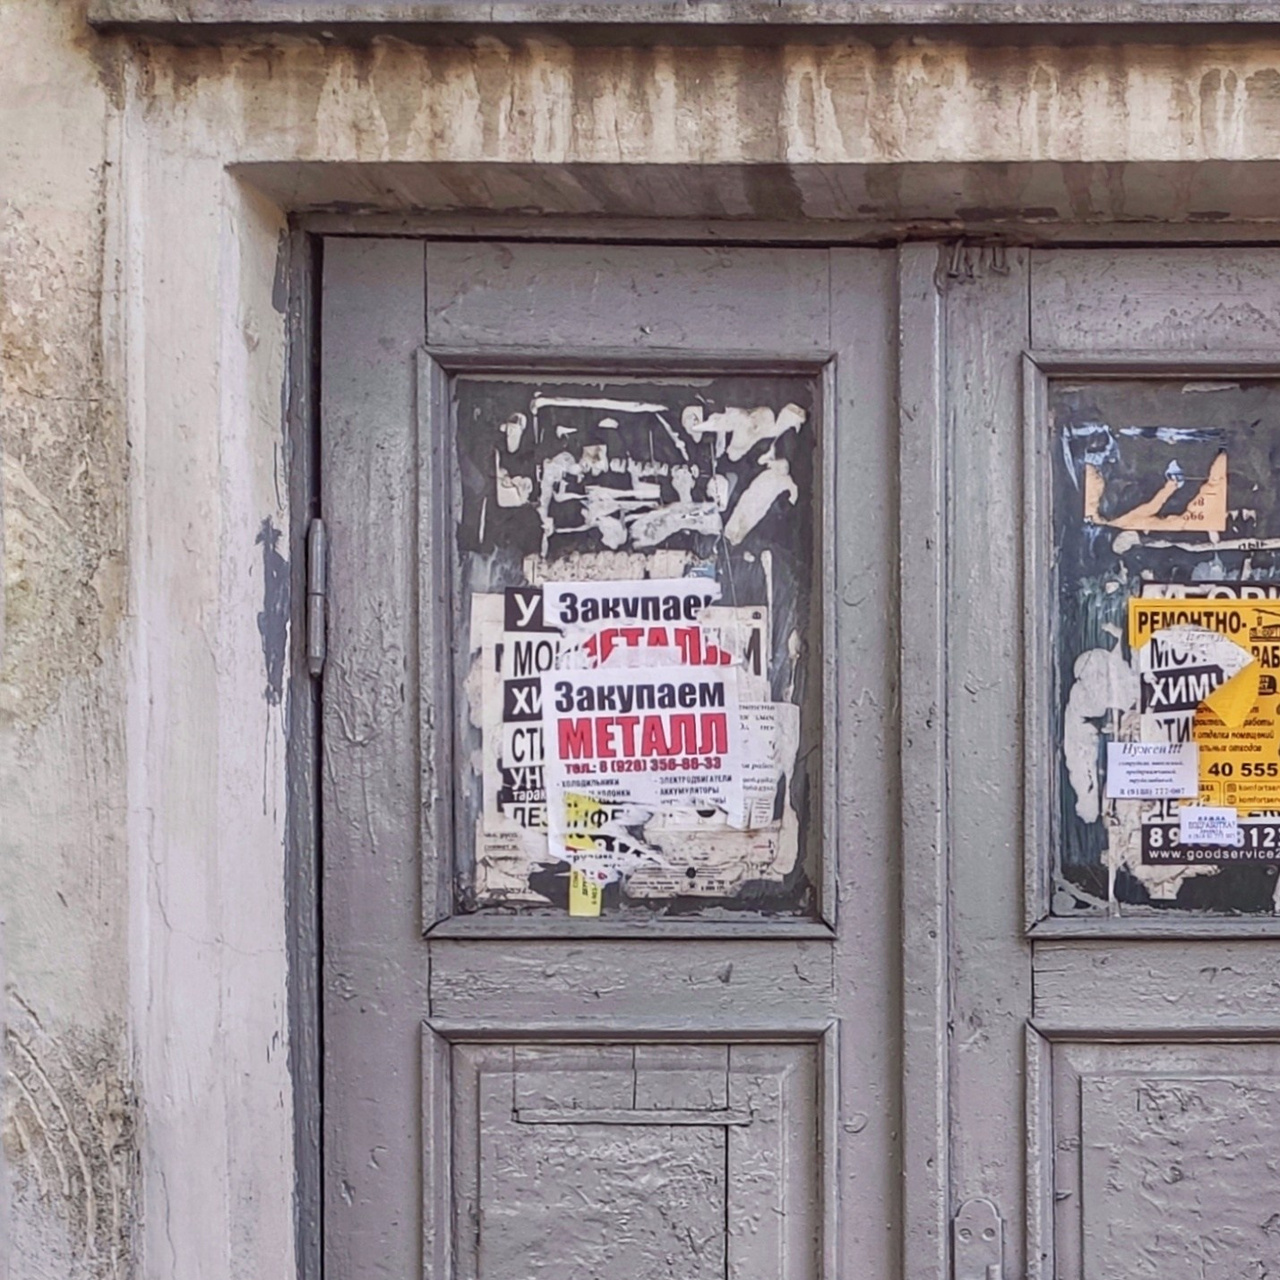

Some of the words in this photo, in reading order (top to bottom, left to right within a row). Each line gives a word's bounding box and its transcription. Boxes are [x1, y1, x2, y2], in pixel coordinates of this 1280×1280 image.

[558, 592, 713, 624] Закупае
[554, 681, 726, 713] Закупаем
[557, 712, 729, 760] МЕТАЛЛ
[1208, 762, 1233, 778] 40
[1240, 762, 1279, 778] 555
